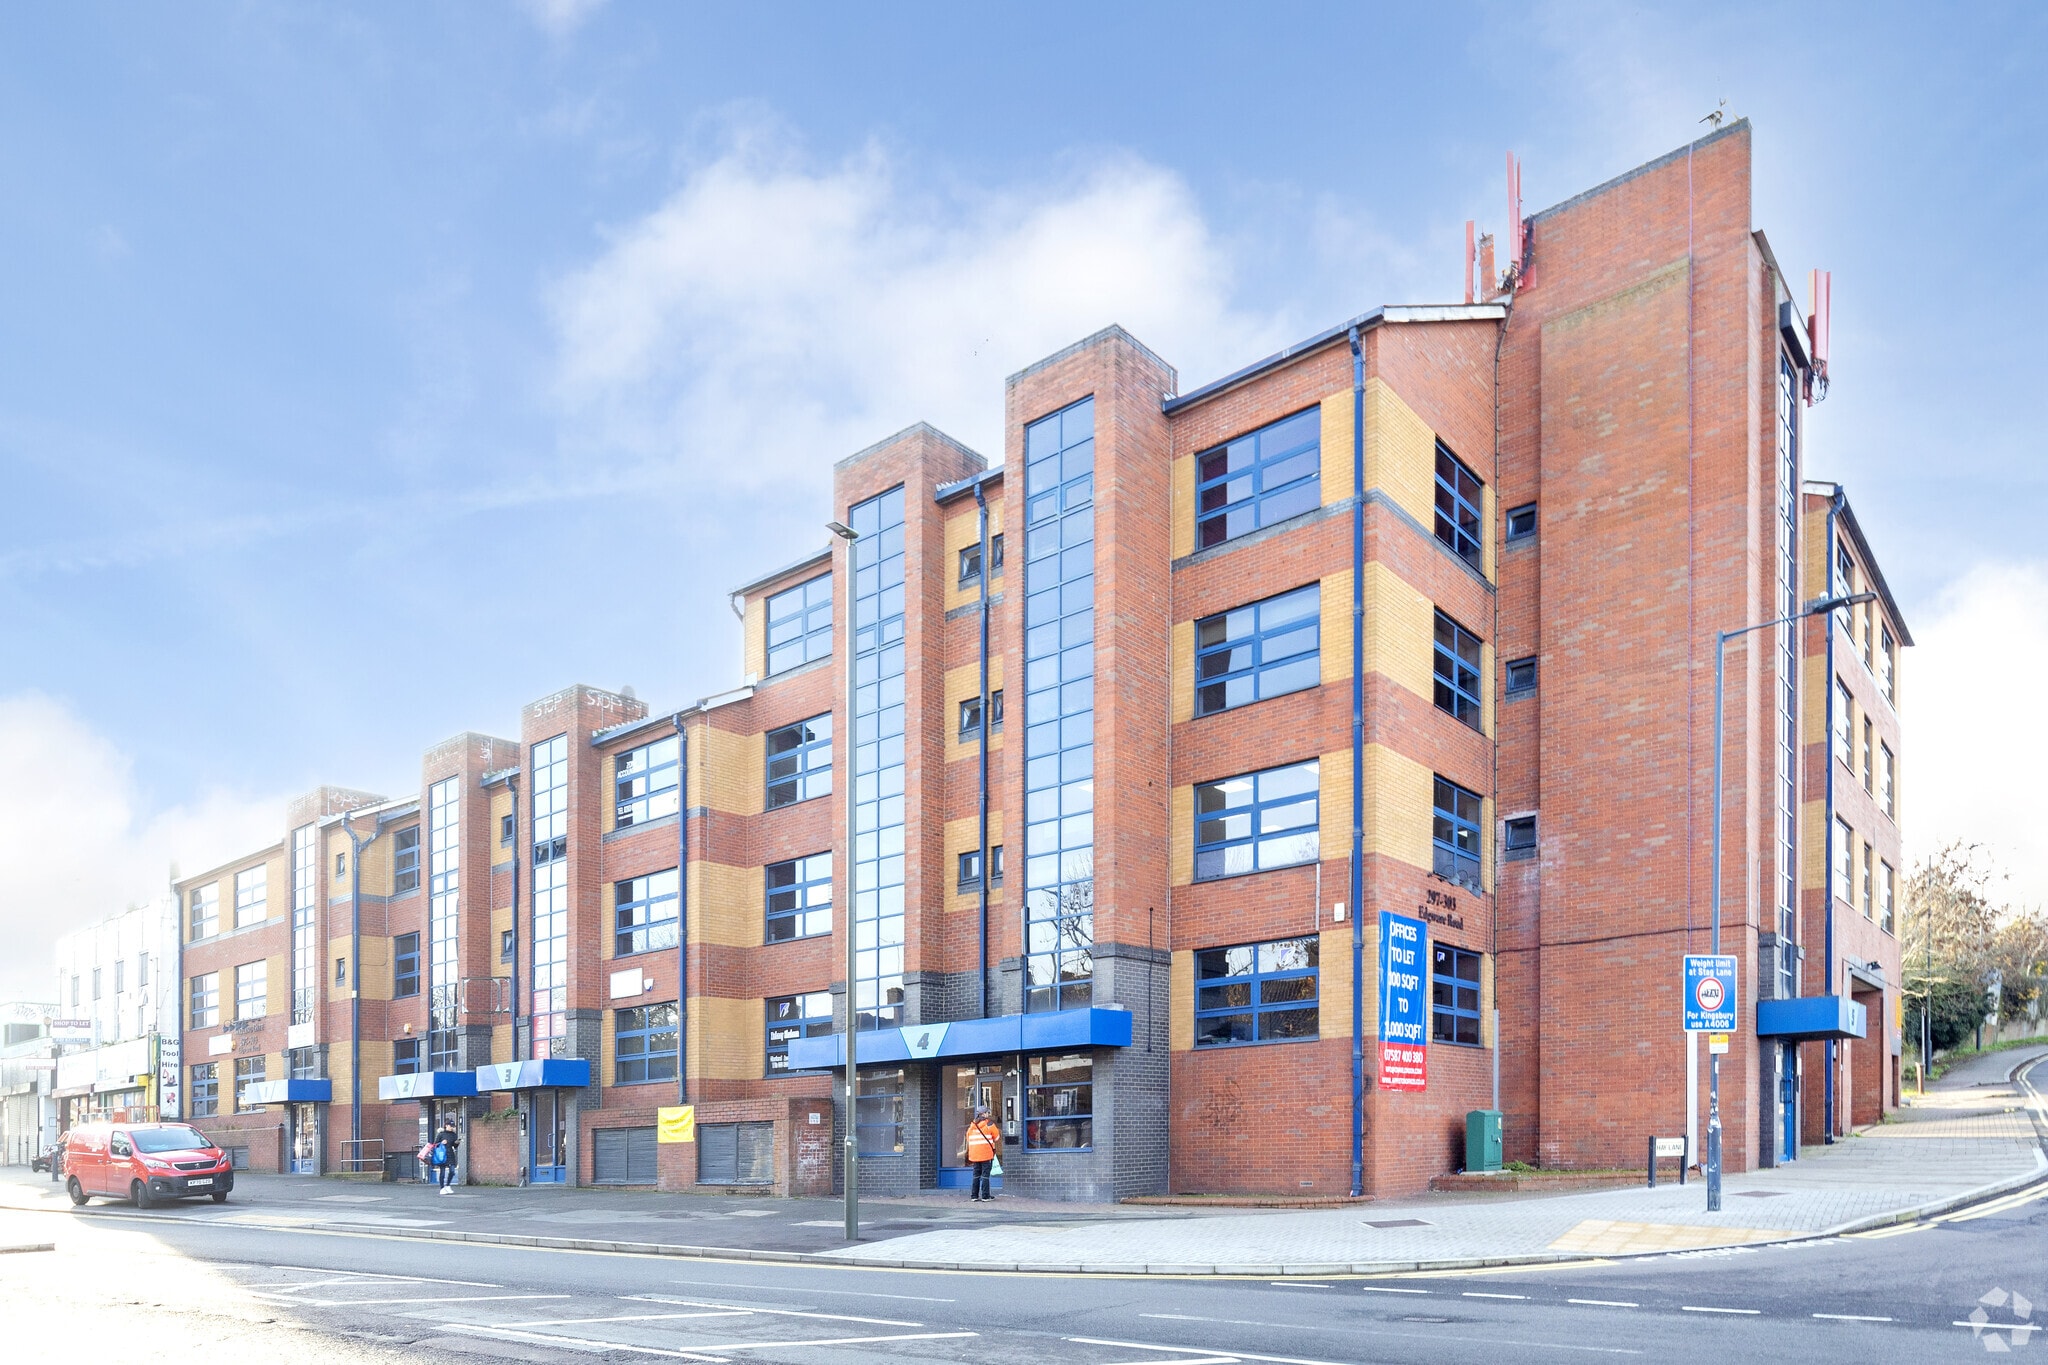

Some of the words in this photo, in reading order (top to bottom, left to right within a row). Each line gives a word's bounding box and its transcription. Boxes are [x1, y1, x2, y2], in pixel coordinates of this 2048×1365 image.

[1447, 914, 1464, 930] Road
[1390, 922, 1417, 942] OFFICES
[1391, 947, 1402, 962] TO
[1403, 950, 1415, 965] LET
[1690, 958, 1714, 968] Weight
[1698, 968, 1715, 977] Stag
[1402, 973, 1419, 991] SQFT
[1398, 997, 1409, 1013] TO
[1701, 1011, 1734, 1021] Kingsbury
[1404, 1023, 1421, 1040] SQFT
[917, 1032, 930, 1050] 4
[505, 1069, 512, 1083] 3
[402, 1080, 409, 1092] 2
